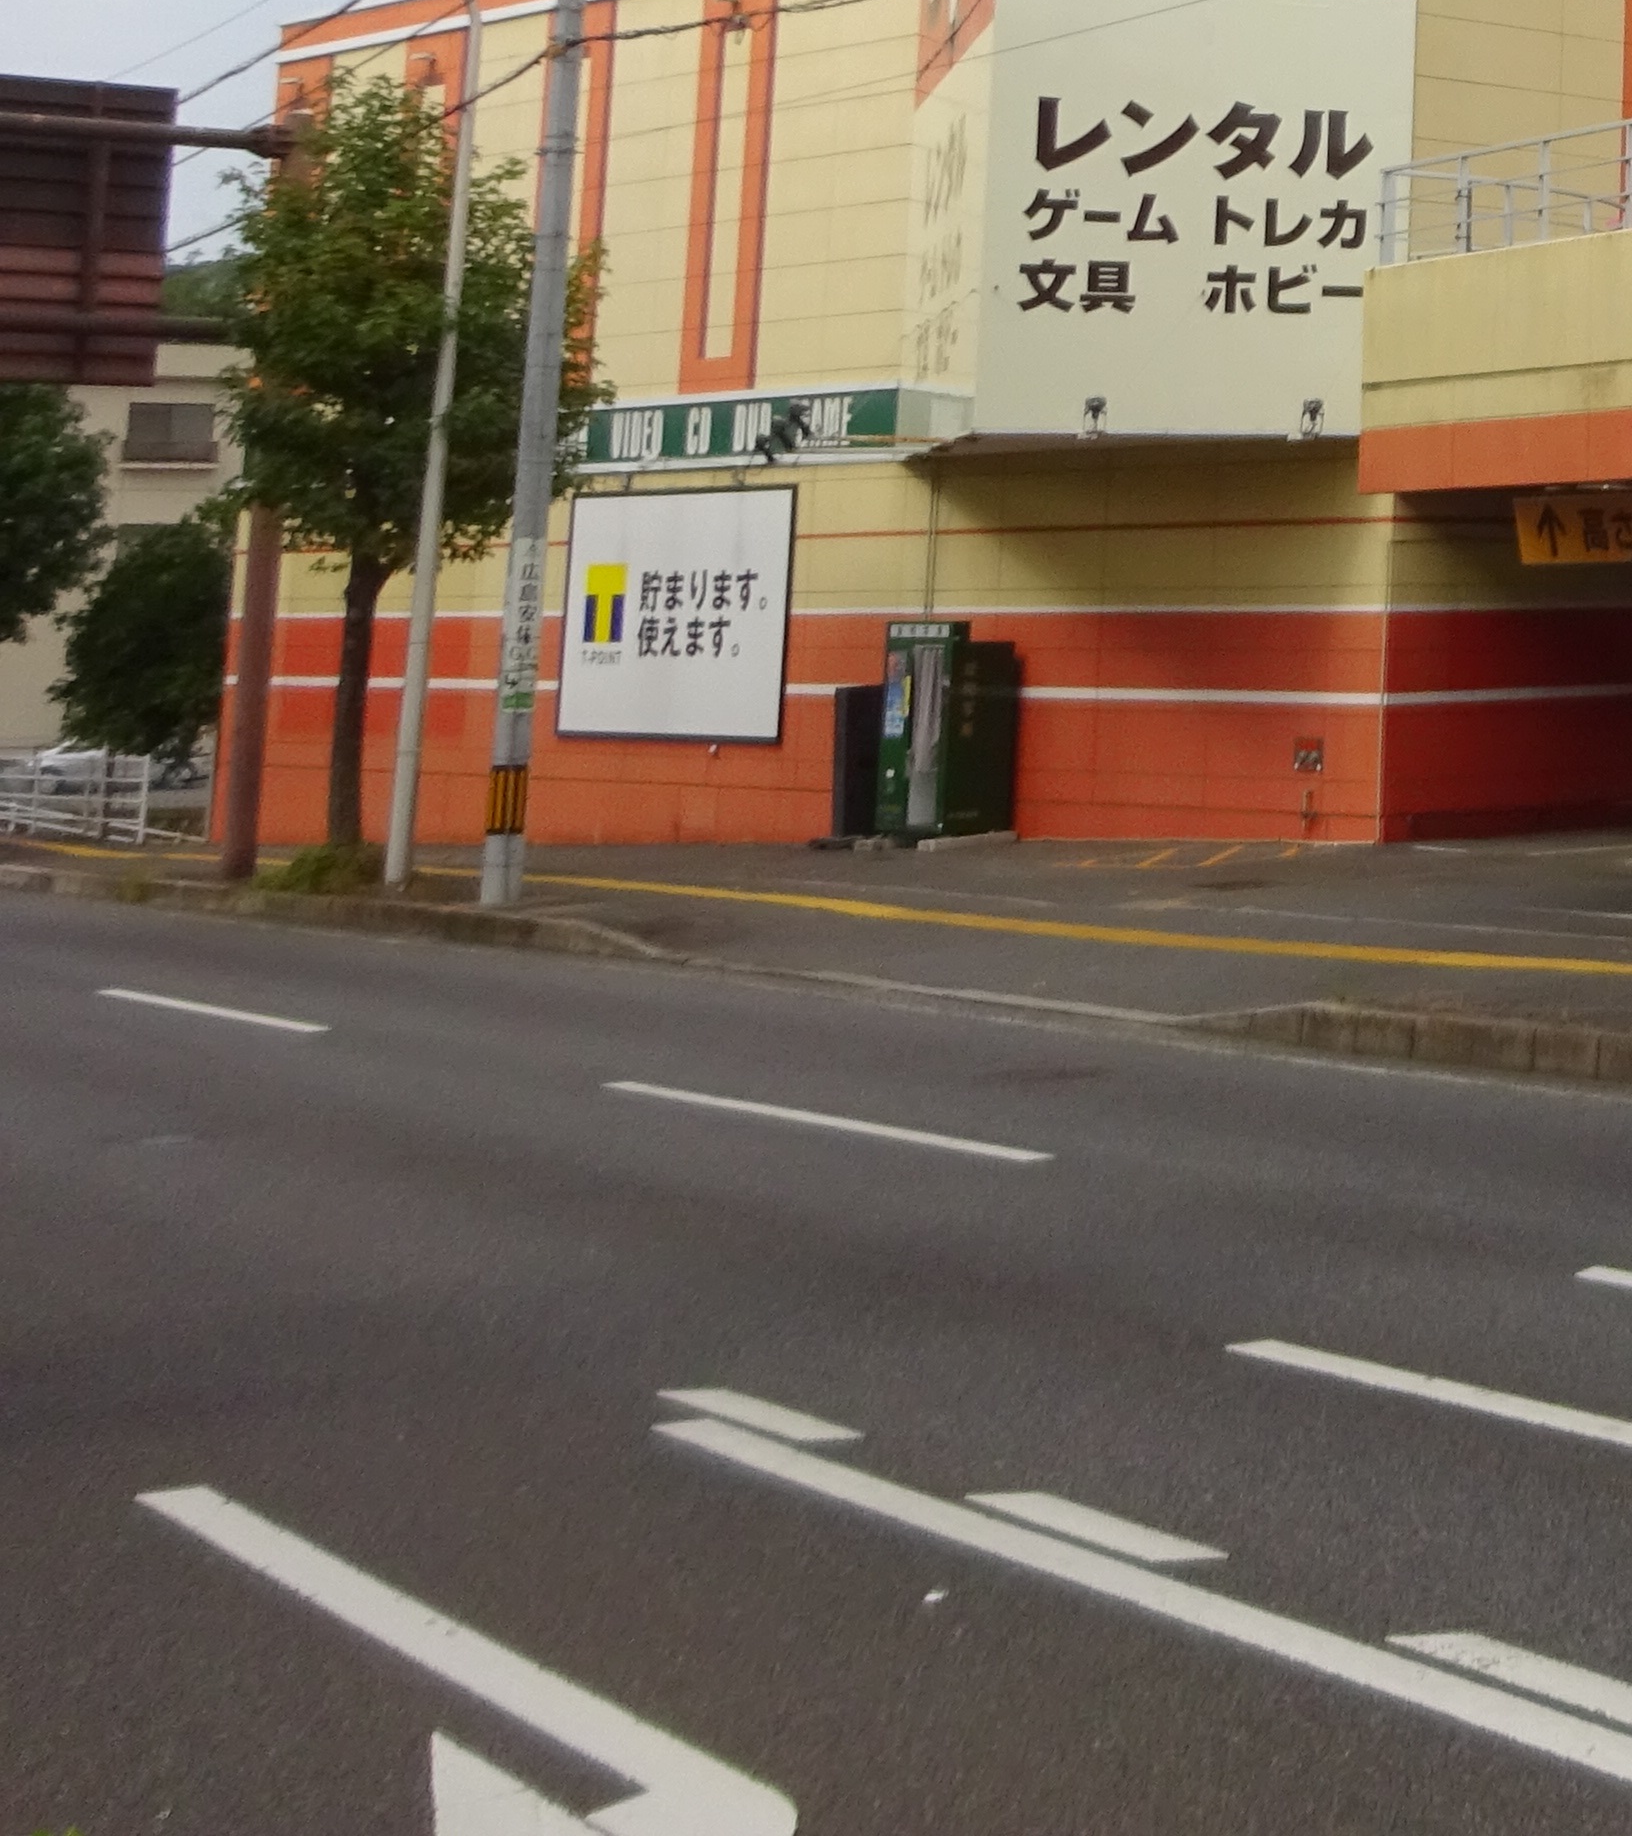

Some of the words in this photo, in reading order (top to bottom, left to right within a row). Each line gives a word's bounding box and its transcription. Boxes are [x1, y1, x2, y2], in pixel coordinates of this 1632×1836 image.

[1037, 96, 1373, 177] レンタル
[1024, 189, 1178, 244] ゲーム
[1214, 195, 1367, 249] トレカ
[1017, 260, 1137, 314] 文具
[1204, 263, 1364, 314] ホビー
[611, 410, 664, 460] VIDEO
[686, 407, 712, 455] CD
[638, 617, 739, 658] 使えます。
